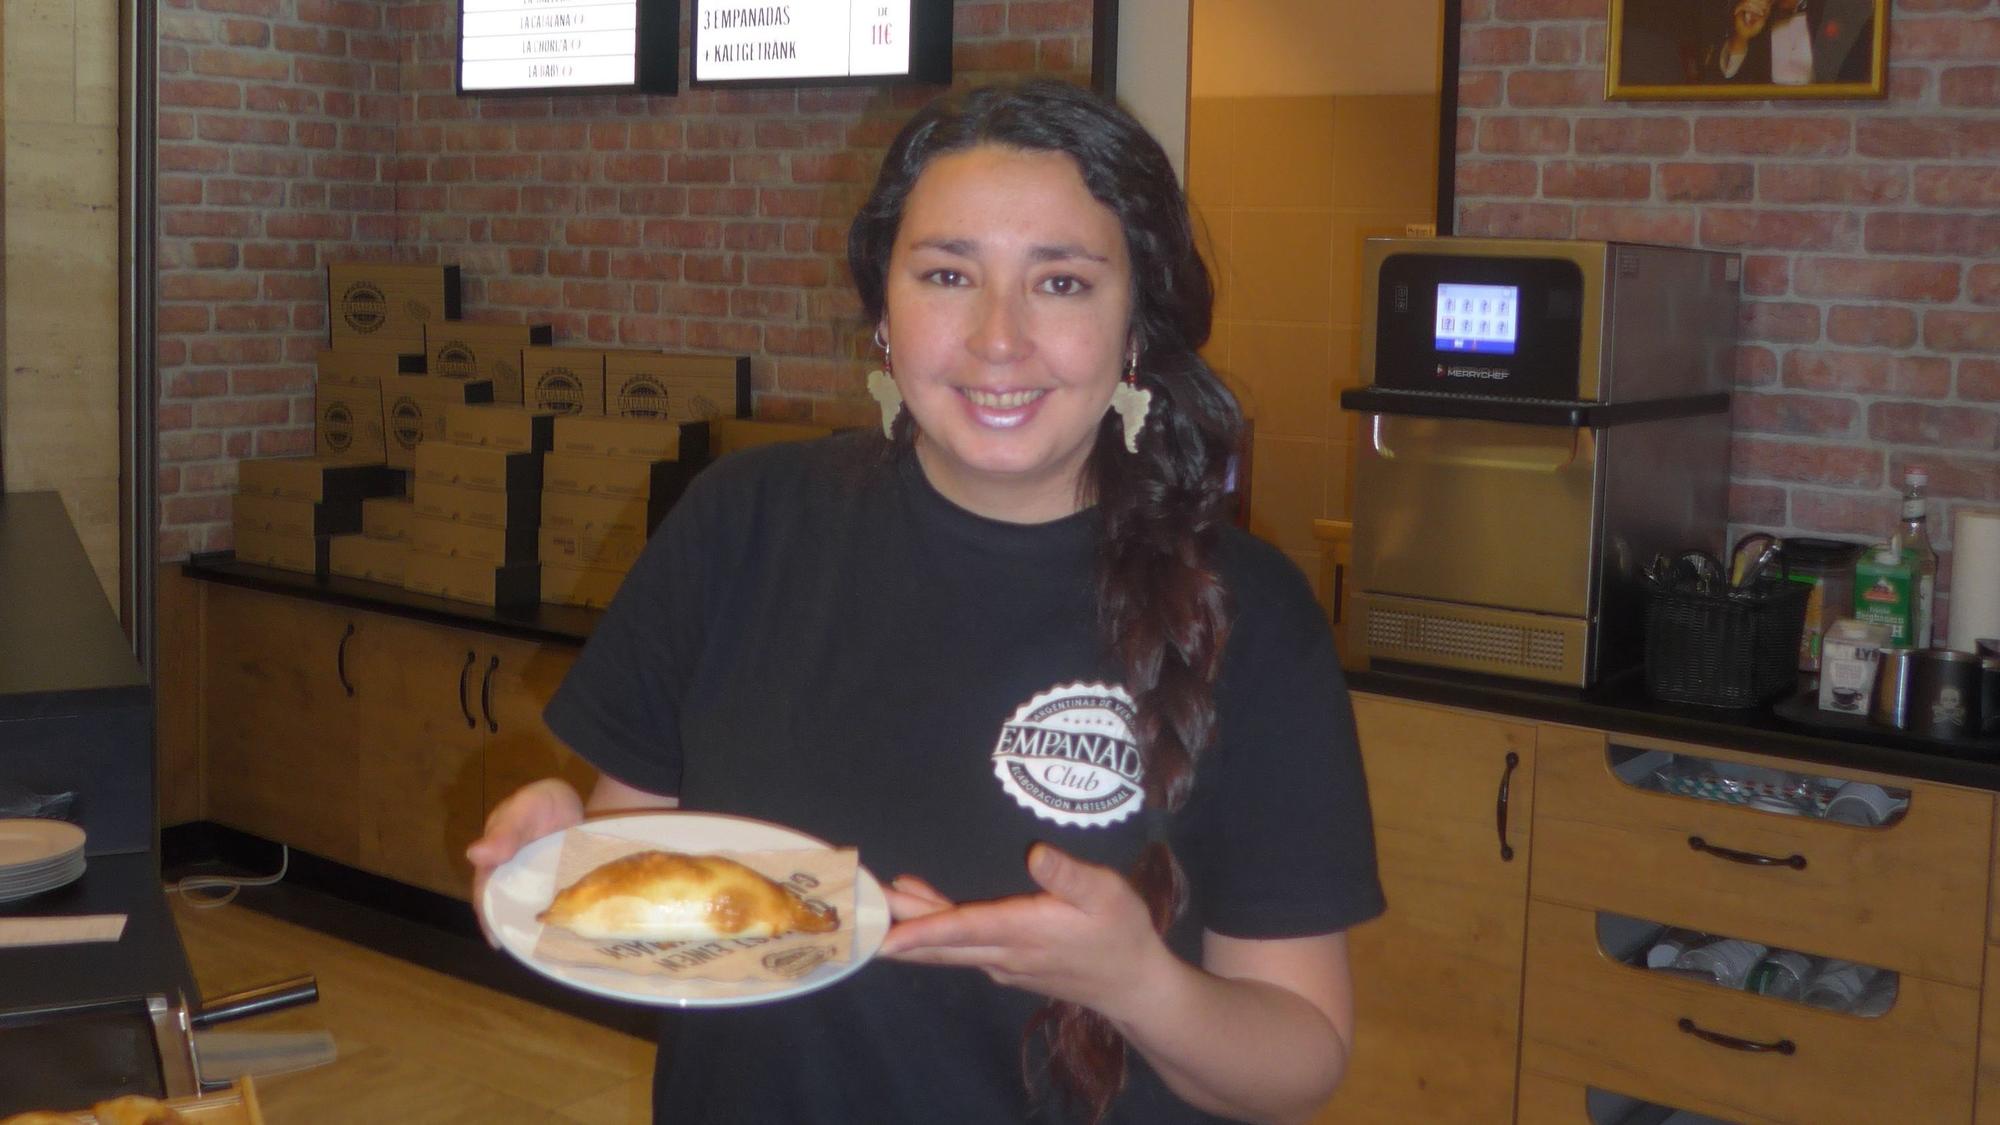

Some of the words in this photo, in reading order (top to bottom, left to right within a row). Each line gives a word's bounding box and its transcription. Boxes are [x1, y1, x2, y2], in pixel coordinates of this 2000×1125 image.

[714, 5, 791, 29] EMPANADAS
[1447, 368, 1510, 380] MERRYCHEF
[1034, 698, 1097, 722] ARGENTINAS
[1098, 699, 1113, 709] DE
[1043, 763, 1100, 792] Club
[1074, 790, 1129, 812] ARTESANAL
